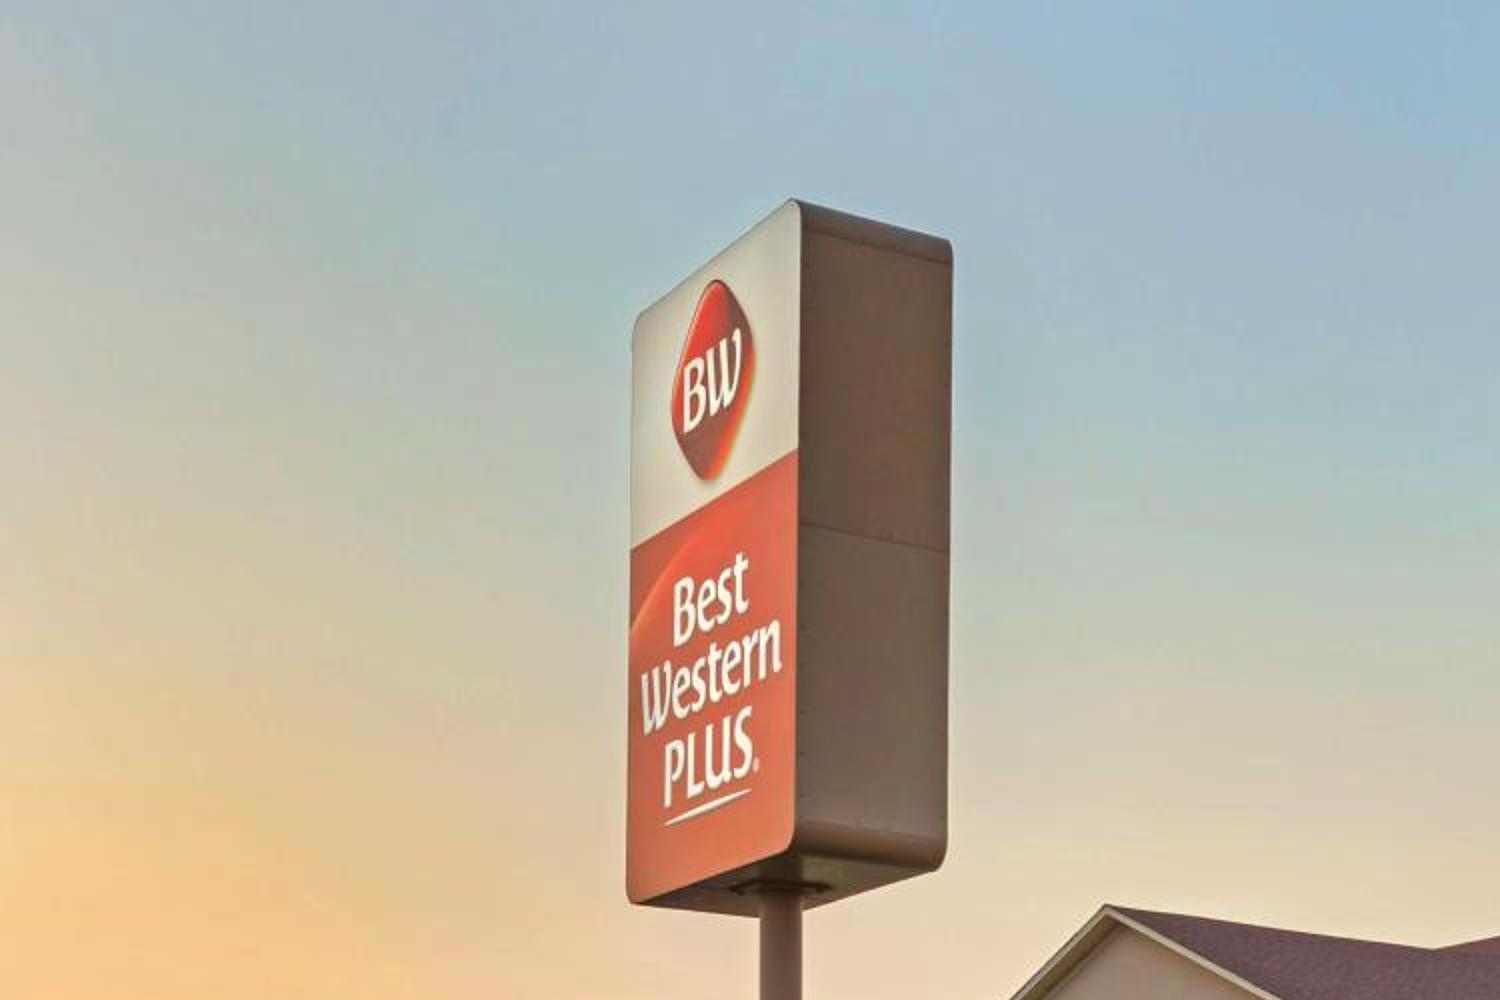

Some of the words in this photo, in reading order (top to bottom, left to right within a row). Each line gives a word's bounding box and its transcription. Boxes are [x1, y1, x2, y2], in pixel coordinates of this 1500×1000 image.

[683, 328, 742, 434] BW
[673, 552, 749, 647] Best
[641, 619, 782, 736] Western
[664, 705, 753, 808] PLUS
